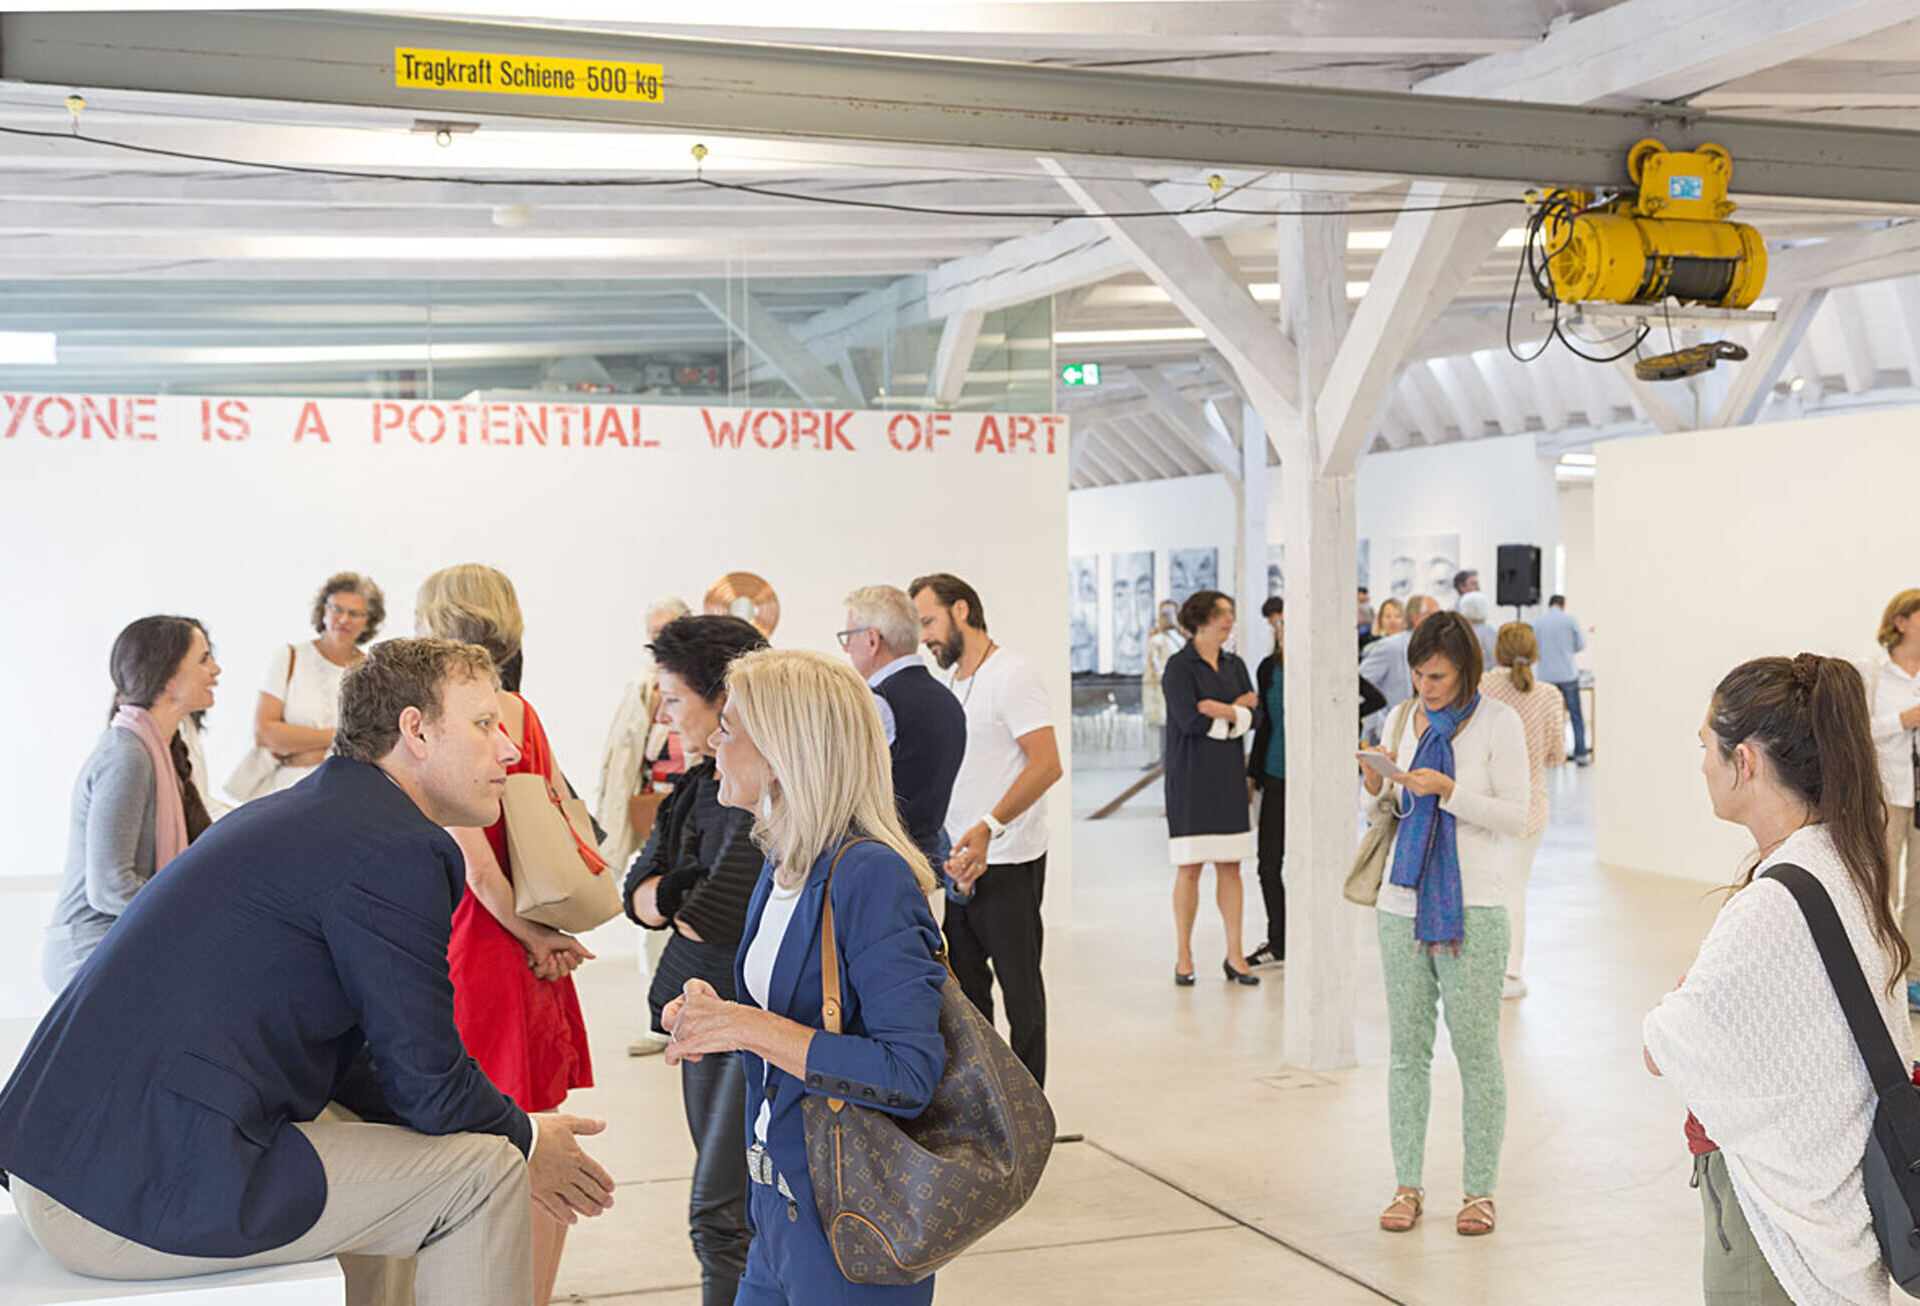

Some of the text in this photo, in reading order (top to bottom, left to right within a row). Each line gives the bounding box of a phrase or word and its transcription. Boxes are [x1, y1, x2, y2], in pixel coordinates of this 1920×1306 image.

[402, 54, 657, 99] Tragkraft Schiene 500 kg
[3, 394, 1065, 457] YONE IS A POTENTIAL WORK OF ART
